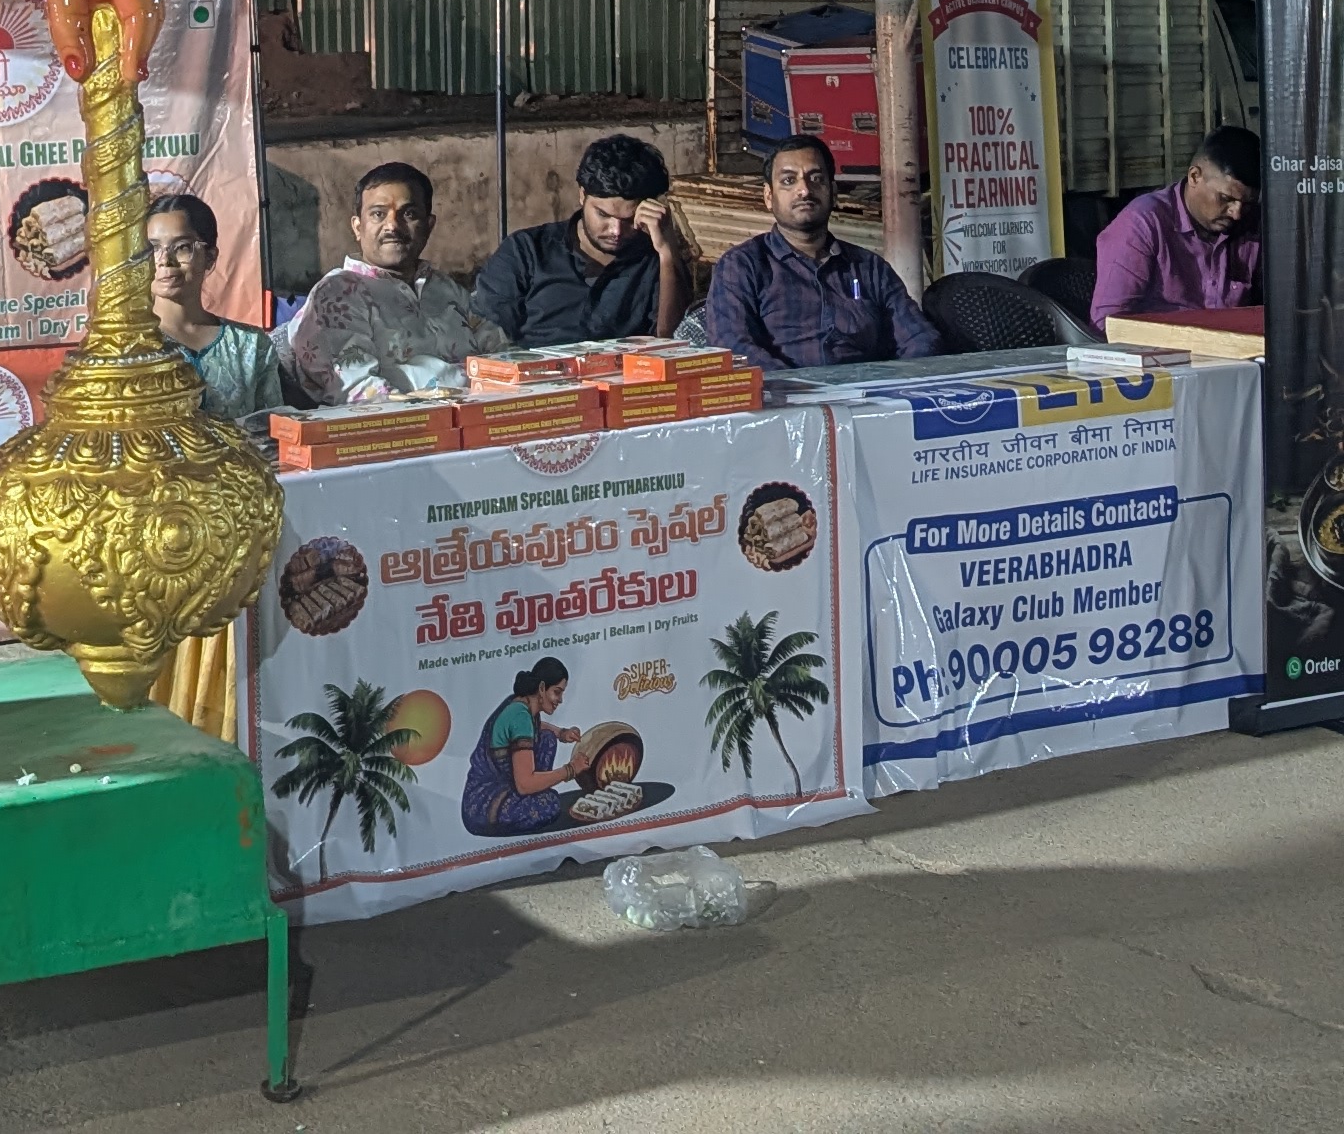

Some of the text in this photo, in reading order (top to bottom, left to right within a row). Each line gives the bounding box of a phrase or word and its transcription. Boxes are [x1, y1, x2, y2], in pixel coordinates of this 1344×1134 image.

[948, 46, 1029, 70] CELEBRATES
[969, 105, 1015, 136] 100%
[19, 139, 69, 167] GHEE
[945, 140, 1040, 172] PRACTICAL
[1270, 155, 1305, 172] Ghar
[1309, 155, 1344, 172] Jaisa
[952, 175, 1038, 209] LEARNING
[1296, 177, 1316, 195] dil
[1320, 181, 1334, 194] se
[963, 220, 1034, 238] WELCOME LEARNERS
[992, 240, 1007, 255] FOR
[23, 288, 87, 316] Special
[38, 317, 71, 339] Dry
[913, 415, 1176, 466] भारतीय जीवन बीमा निगम
[911, 437, 1177, 485] LIFE INSURANCE CORPORATION OF INDIA
[427, 472, 686, 524] ATREYAPURAM SPECIAL GHEE PUTHAREKULU
[913, 493, 1174, 548] For More Details Contact:
[959, 540, 1134, 588] VEERABHADRA
[415, 594, 486, 645] నేతి
[932, 579, 1163, 634] Galaxy Club Member
[418, 612, 699, 670] Made with Pure Special Ghee Sugar Bellam Dry Fruits
[1088, 609, 1215, 666] 98288
[1304, 657, 1341, 675] Order
